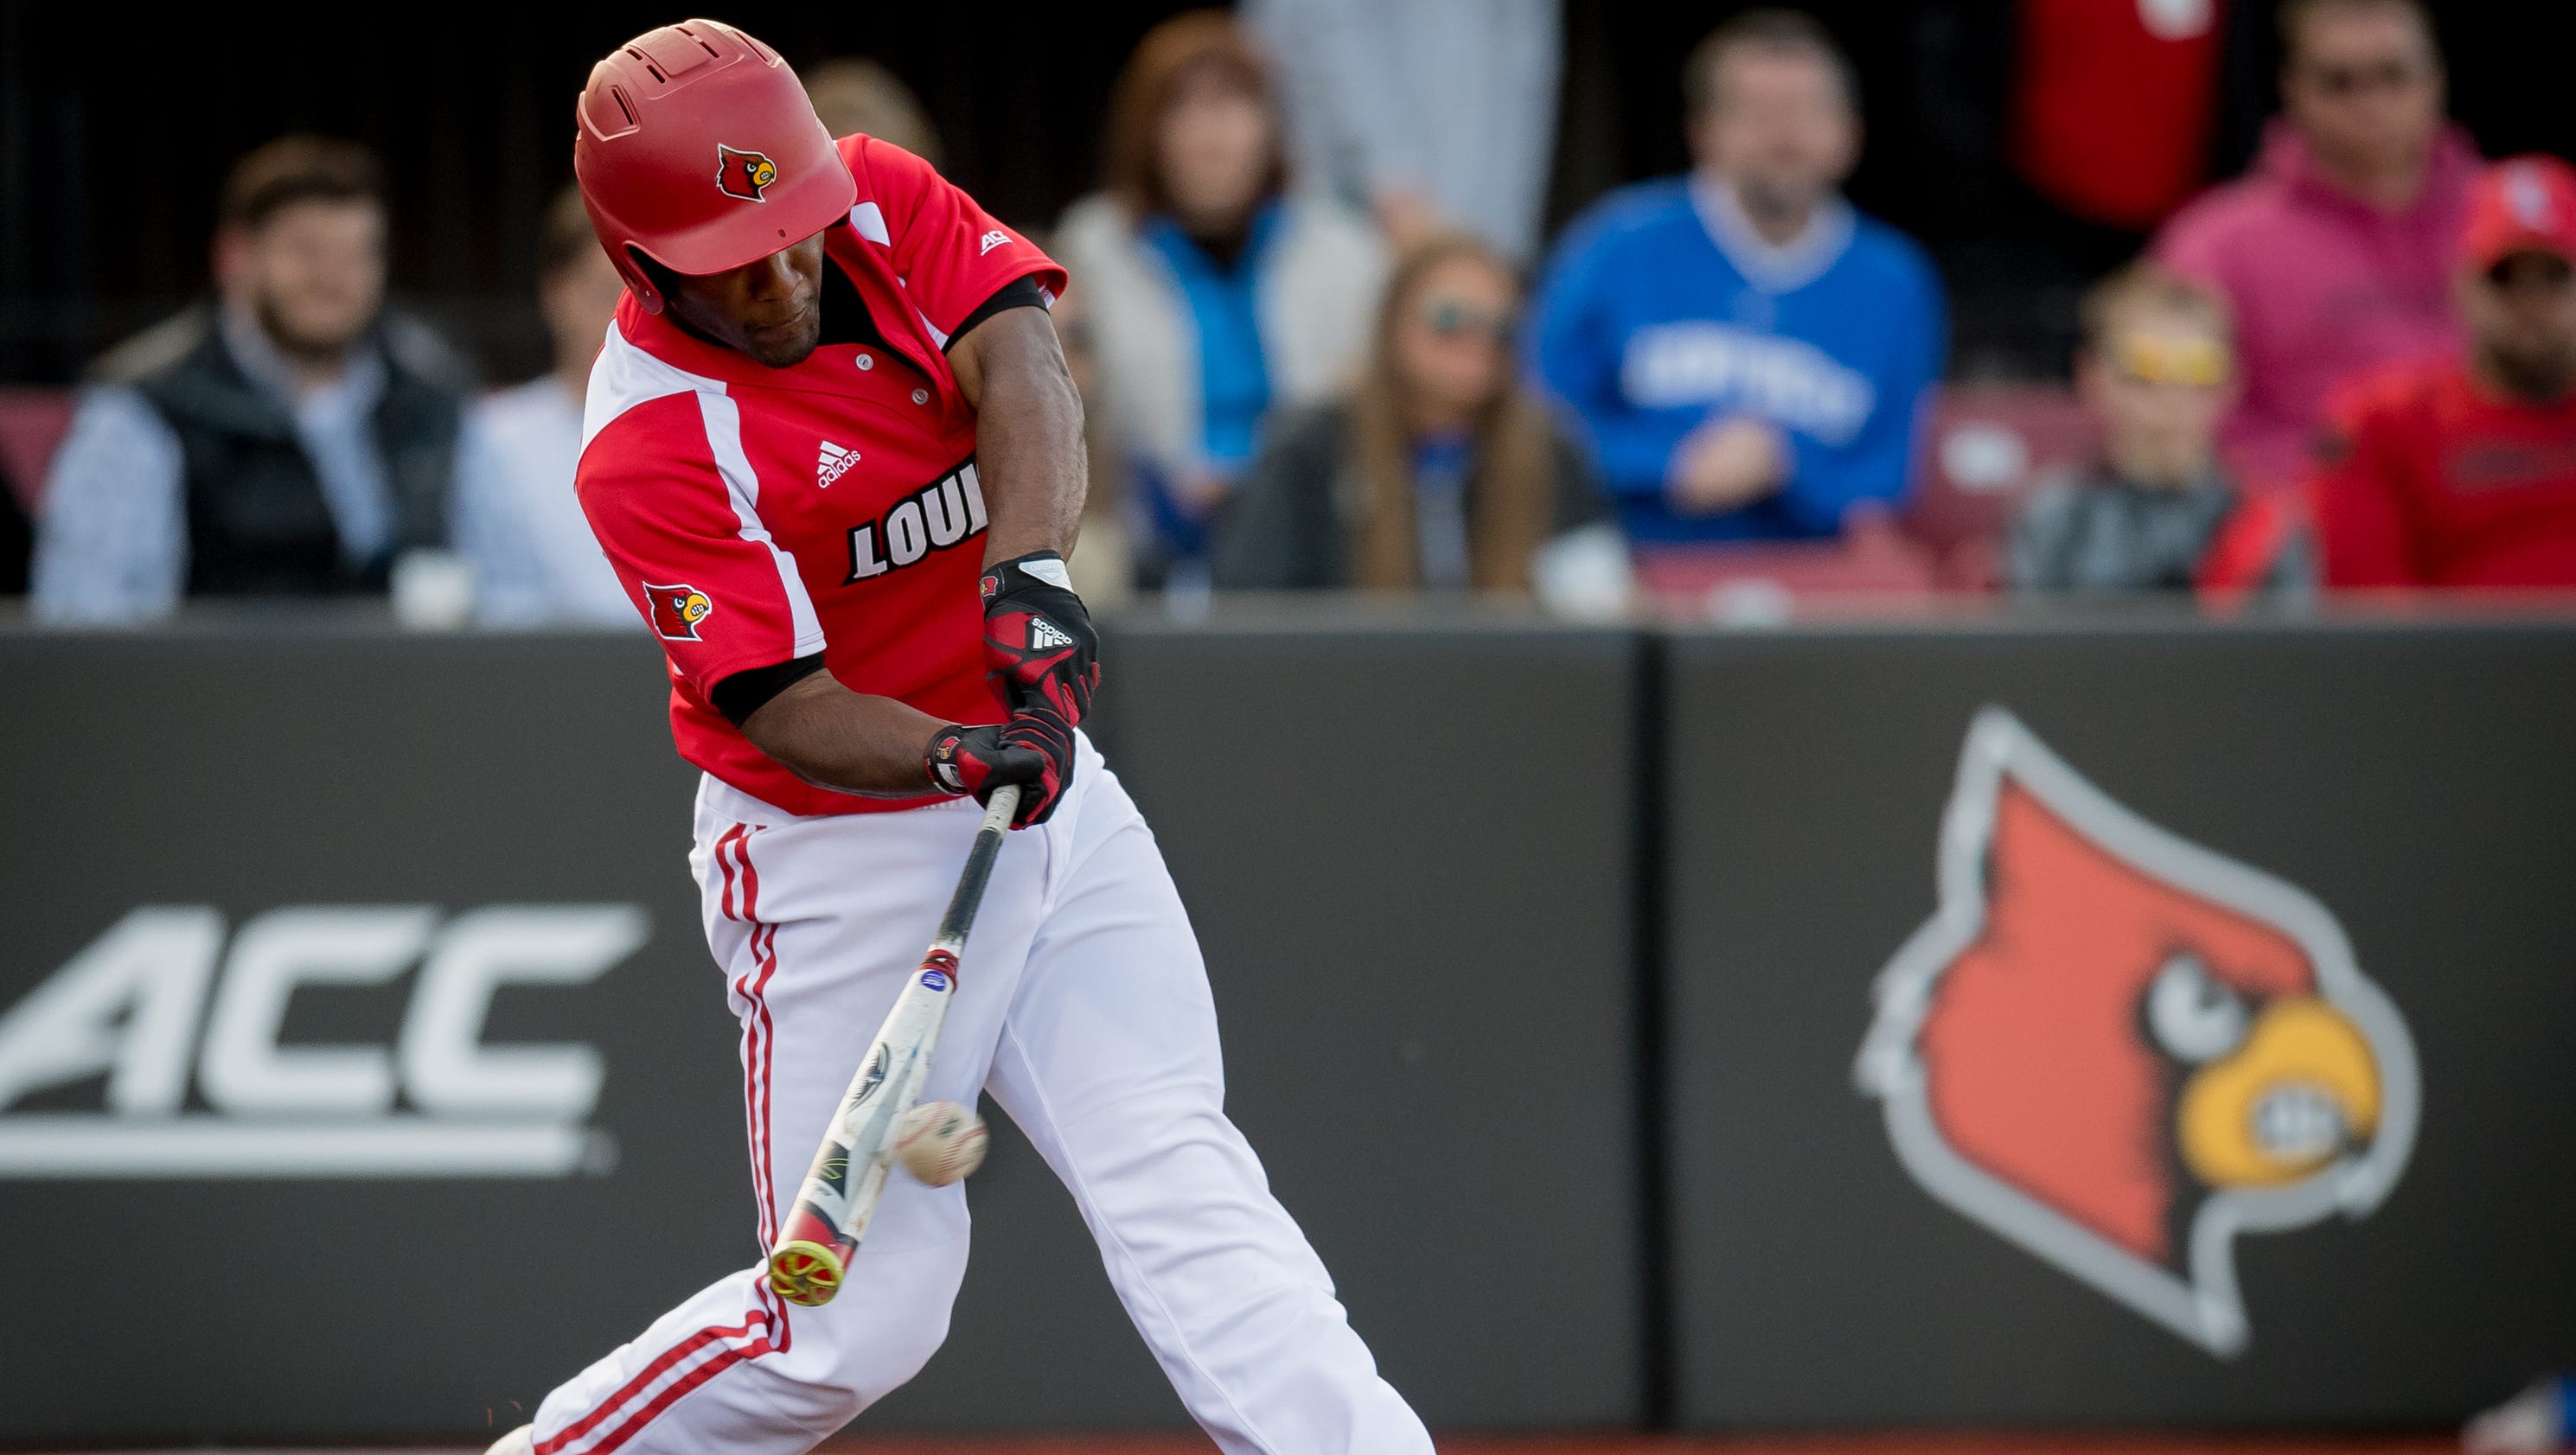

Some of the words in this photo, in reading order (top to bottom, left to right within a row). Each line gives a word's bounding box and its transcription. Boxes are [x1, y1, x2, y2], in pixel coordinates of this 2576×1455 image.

[818, 450, 861, 488] adidas
[1032, 617, 1073, 645] adidas
[0, 903, 650, 1117] ACC
